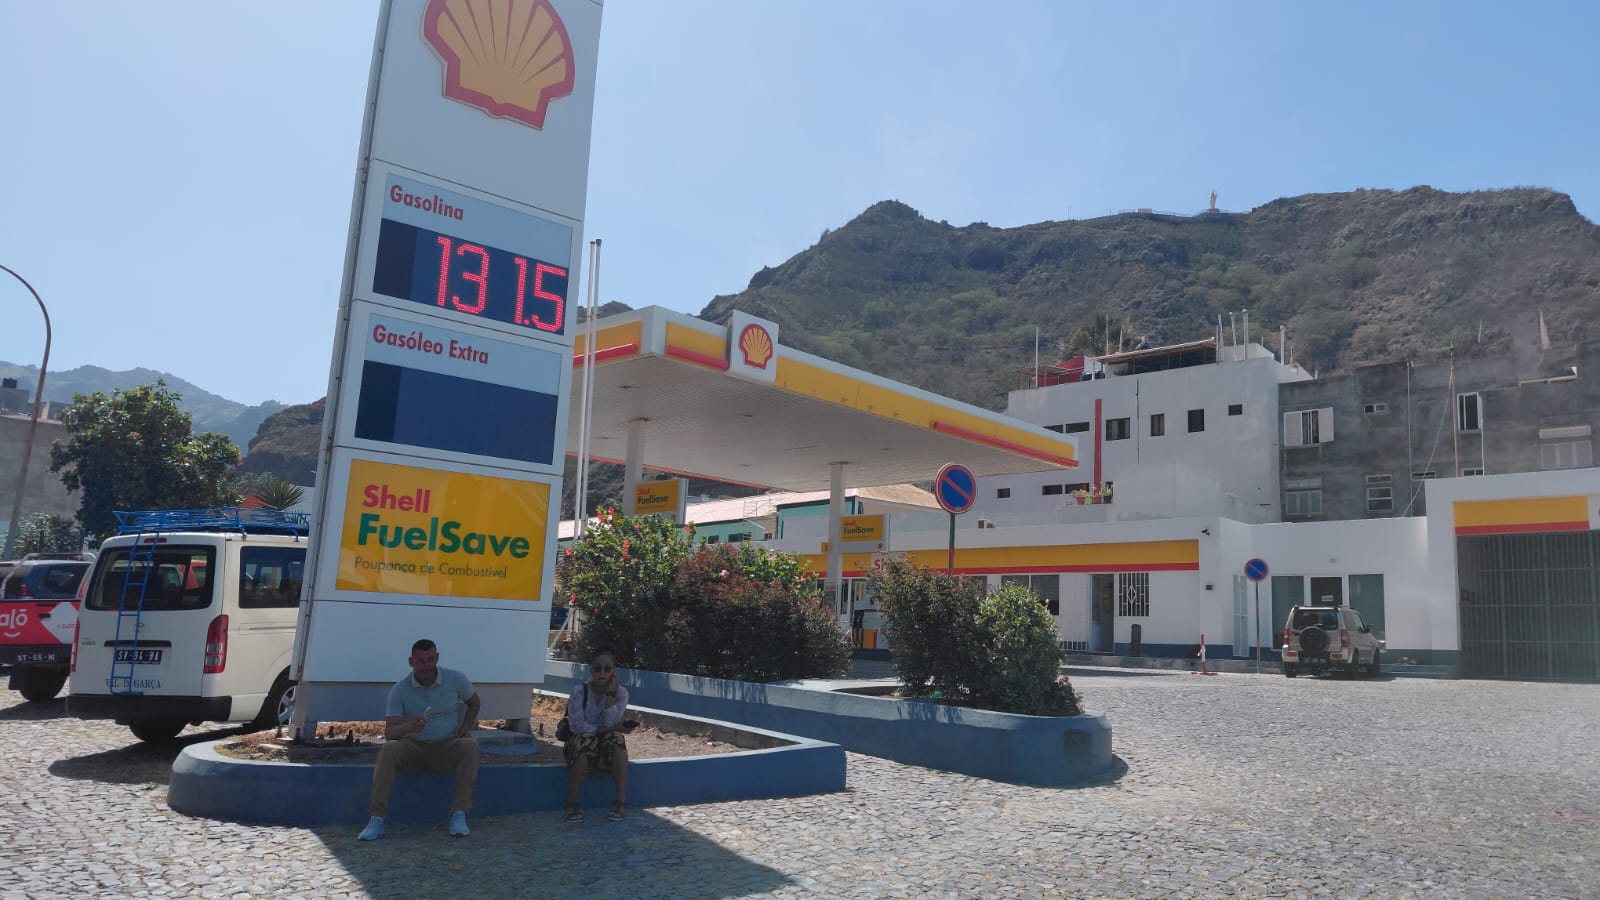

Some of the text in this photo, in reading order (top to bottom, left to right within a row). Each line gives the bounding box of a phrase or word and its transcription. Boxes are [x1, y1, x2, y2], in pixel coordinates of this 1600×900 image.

[390, 184, 464, 221] Gasolina
[373, 324, 489, 365] Gasóleo Extra
[362, 484, 431, 514] Shell
[638, 495, 669, 504] FuelSave
[358, 512, 531, 559] FuelSave
[843, 526, 875, 535] FuelSave
[354, 556, 416, 573] Poupança
[420, 561, 435, 574] de
